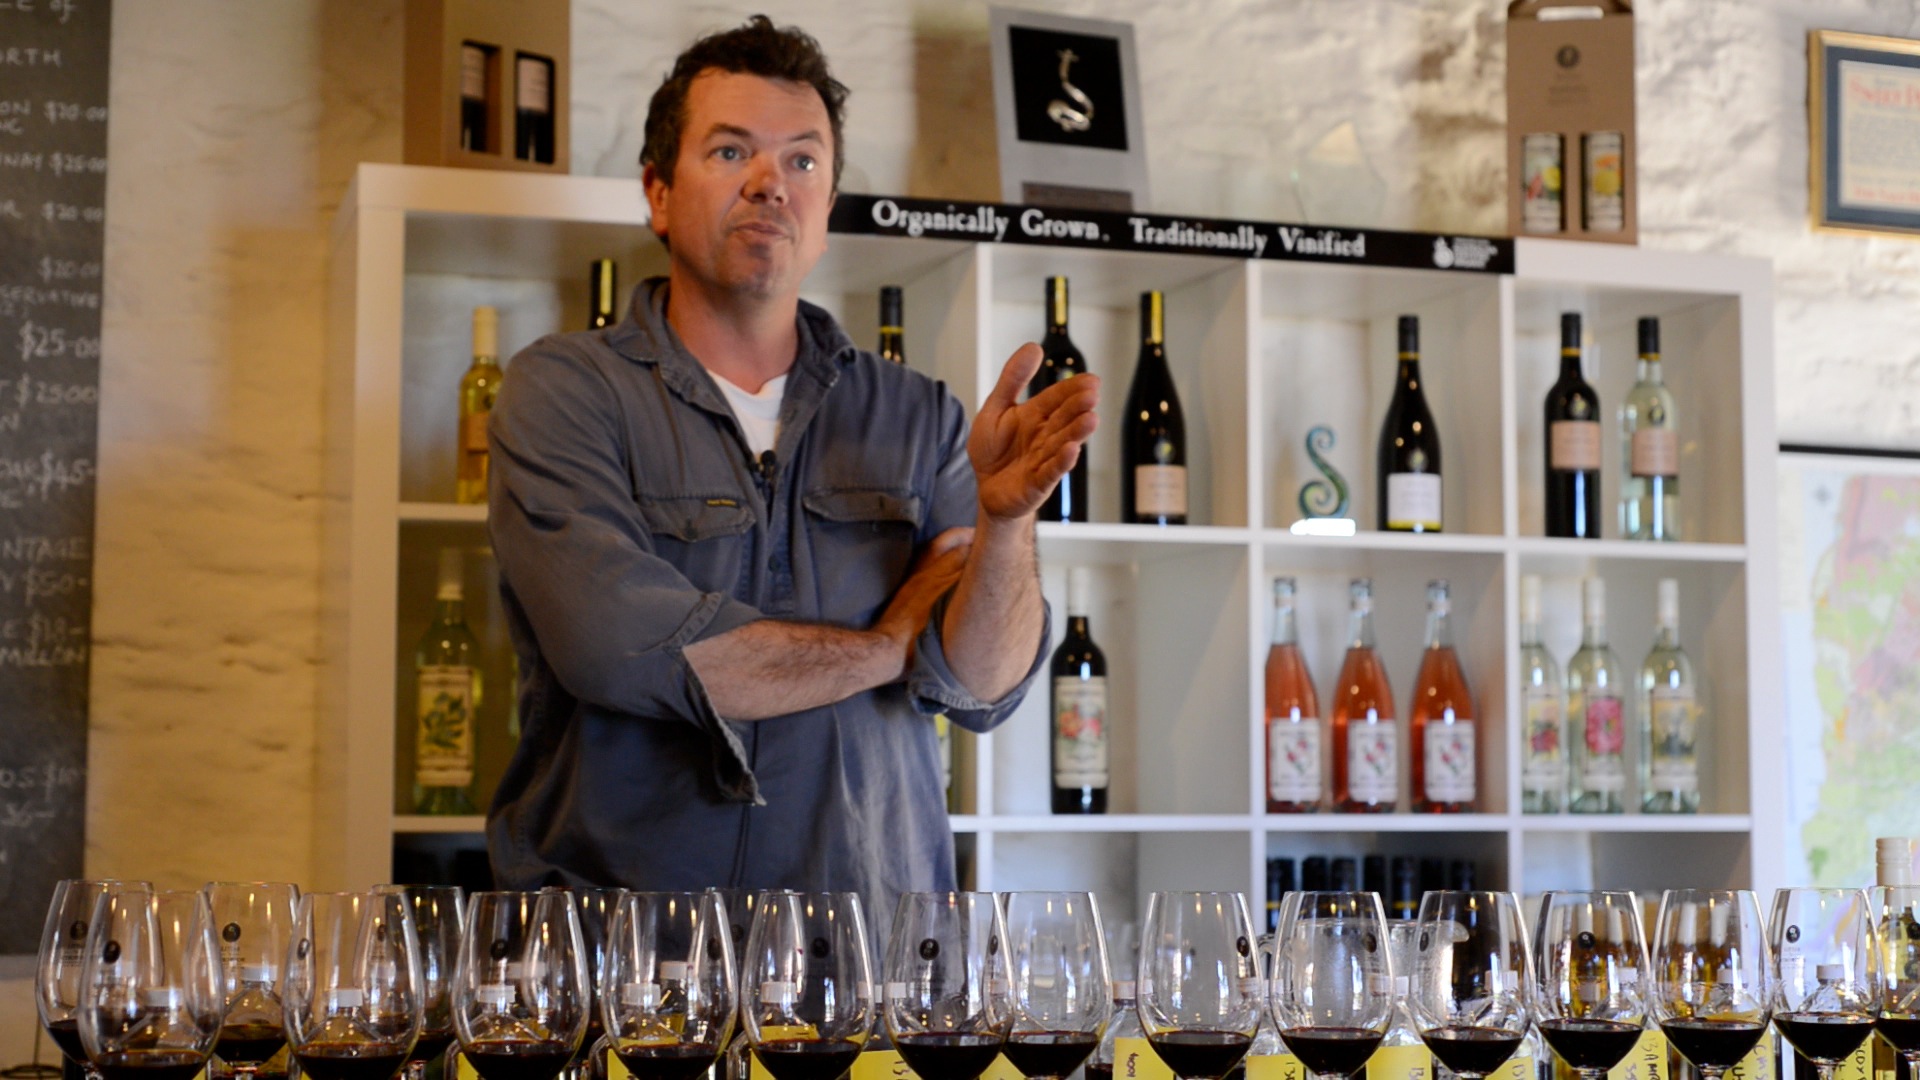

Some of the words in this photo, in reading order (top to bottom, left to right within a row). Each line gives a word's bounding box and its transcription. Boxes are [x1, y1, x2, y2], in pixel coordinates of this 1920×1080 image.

[0, 47, 62, 68] RTH
[872, 199, 1009, 242] Organically
[1129, 218, 1267, 257] Traditionally
[1278, 227, 1366, 258] Vinified
